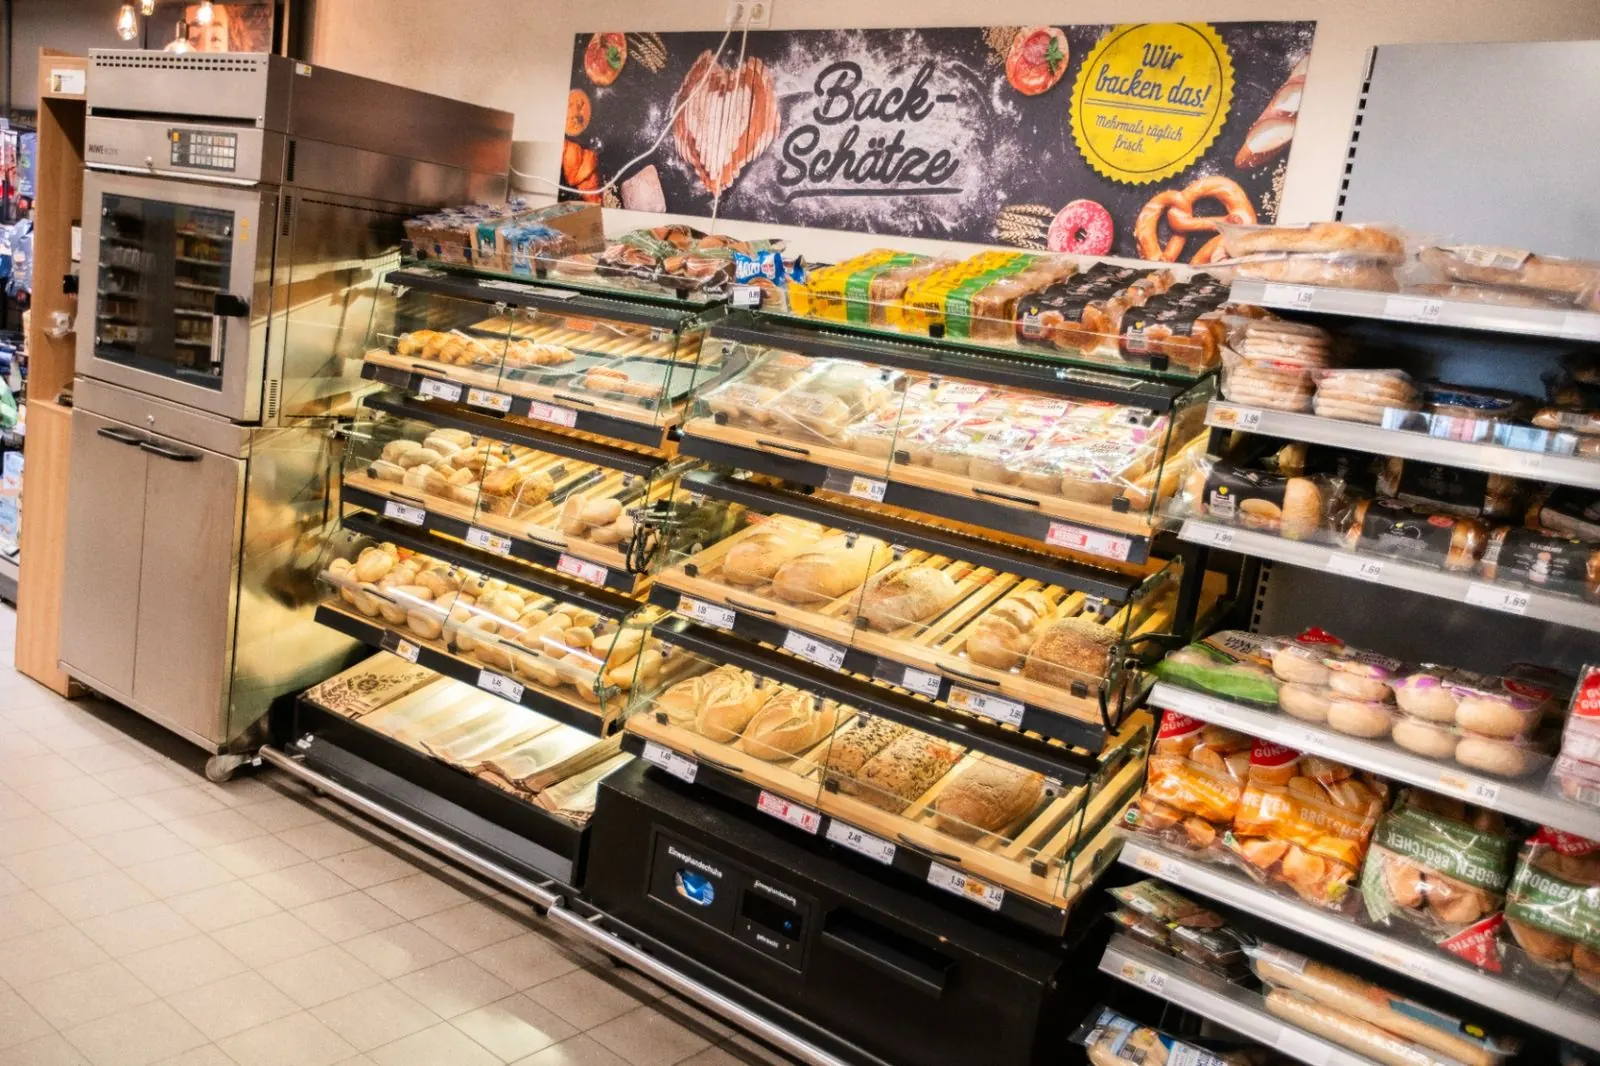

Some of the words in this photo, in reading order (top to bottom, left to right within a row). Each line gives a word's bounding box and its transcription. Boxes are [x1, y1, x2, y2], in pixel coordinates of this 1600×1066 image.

[1140, 43, 1183, 70] Wir
[813, 61, 956, 126] Back-
[1095, 64, 1163, 101] backen
[1167, 76, 1212, 108] das!
[1095, 115, 1145, 135] Mehrmals
[1144, 124, 1182, 143] täglich
[1112, 136, 1145, 154] frisch.
[778, 124, 959, 187] Schätze
